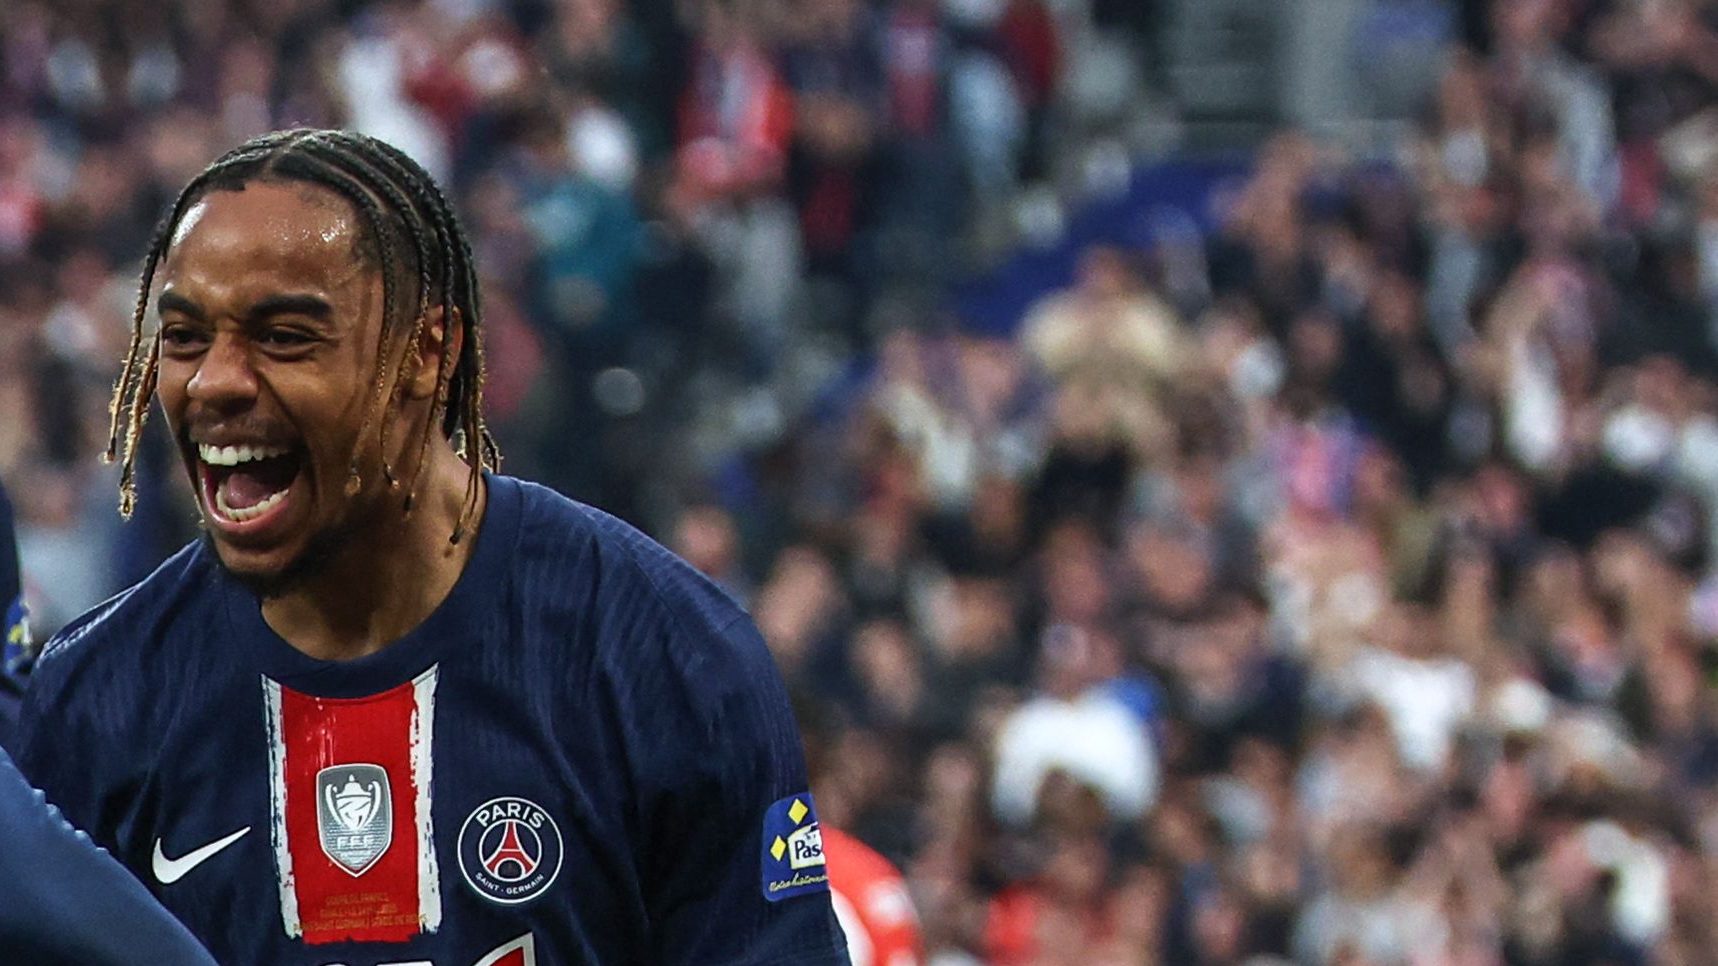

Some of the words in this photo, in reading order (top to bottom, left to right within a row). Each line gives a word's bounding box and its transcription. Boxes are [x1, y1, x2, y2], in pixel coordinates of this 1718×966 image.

[476, 802, 545, 828] PARIS
[475, 871, 500, 892] SAINT
[506, 873, 545, 895] GERMAIN
